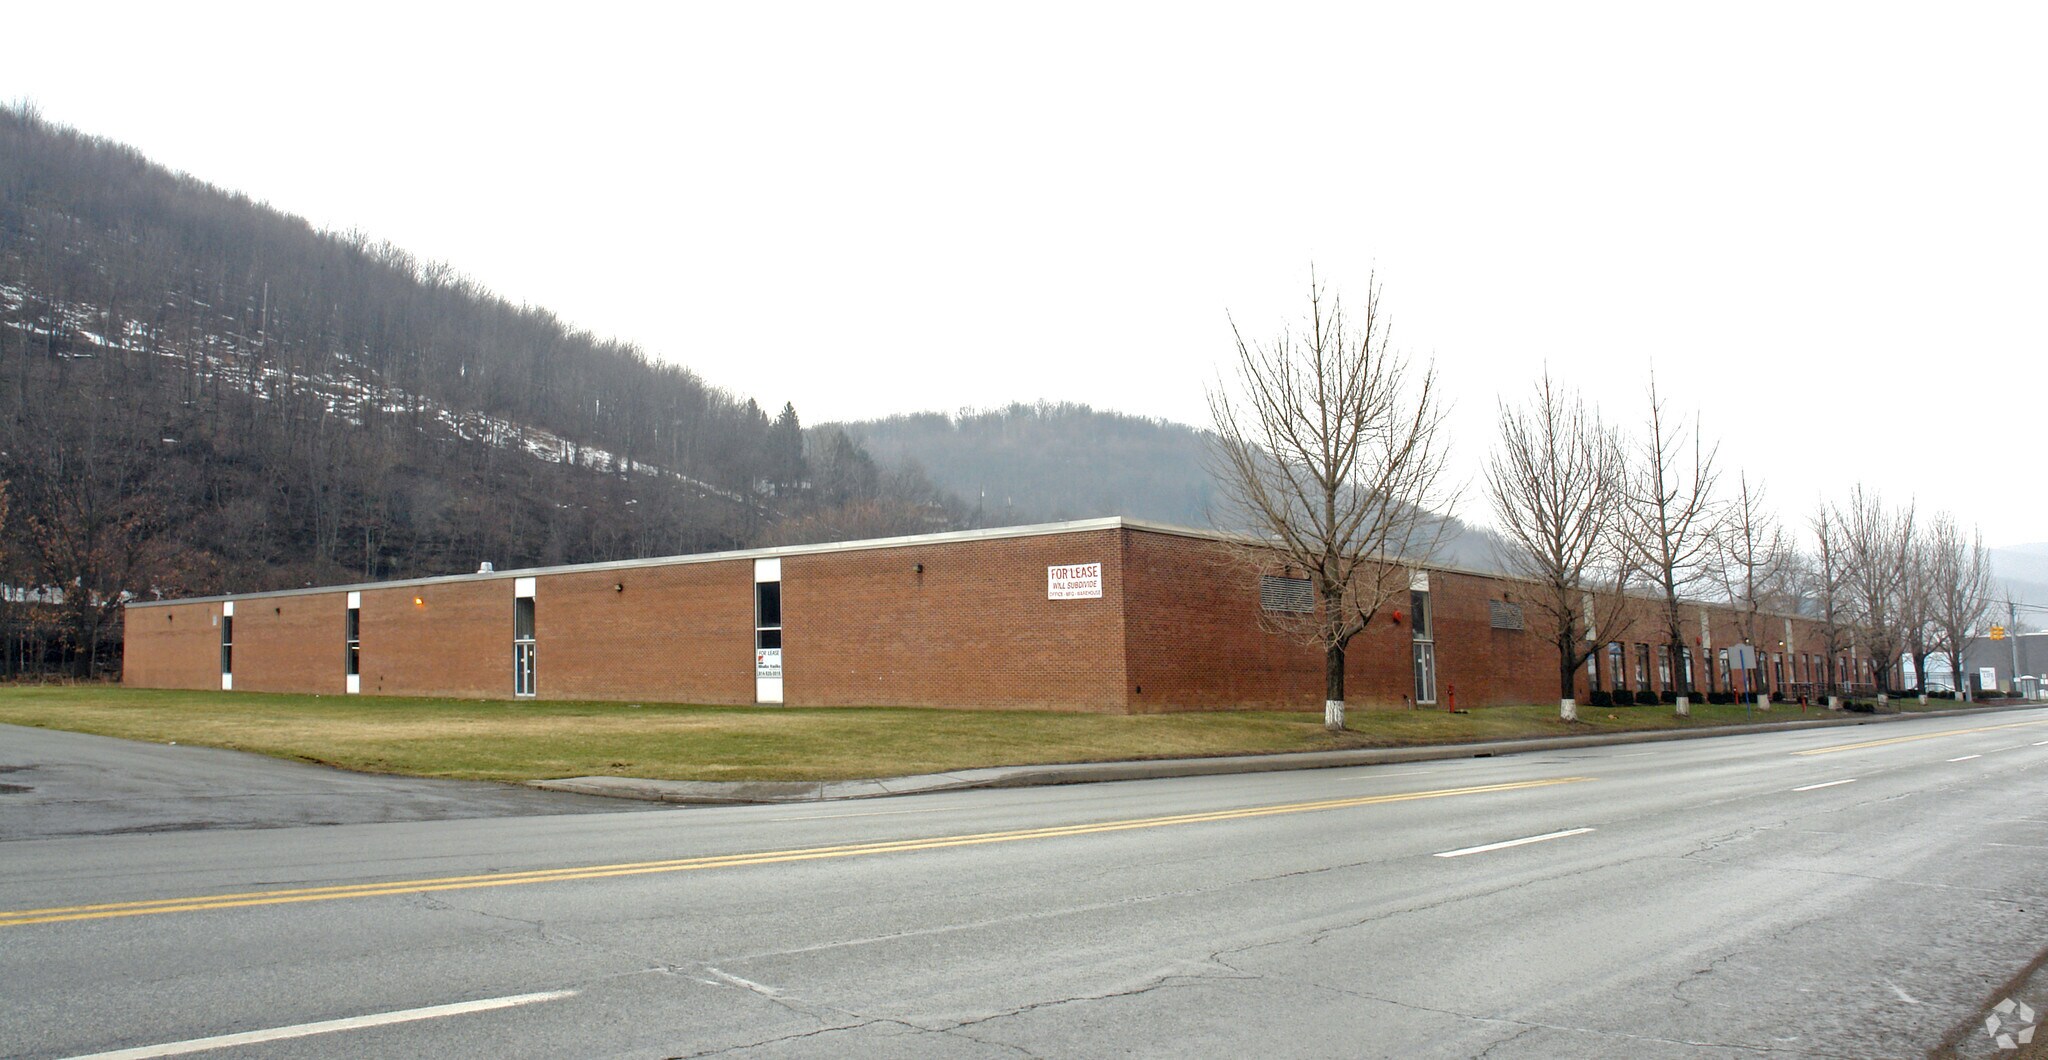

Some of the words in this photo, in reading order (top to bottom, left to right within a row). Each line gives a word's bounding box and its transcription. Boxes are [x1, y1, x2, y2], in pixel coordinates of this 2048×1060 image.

[1051, 568, 1068, 579] FOR
[1070, 566, 1098, 579] LEASE
[1067, 580, 1097, 589] SUBDIVIDE
